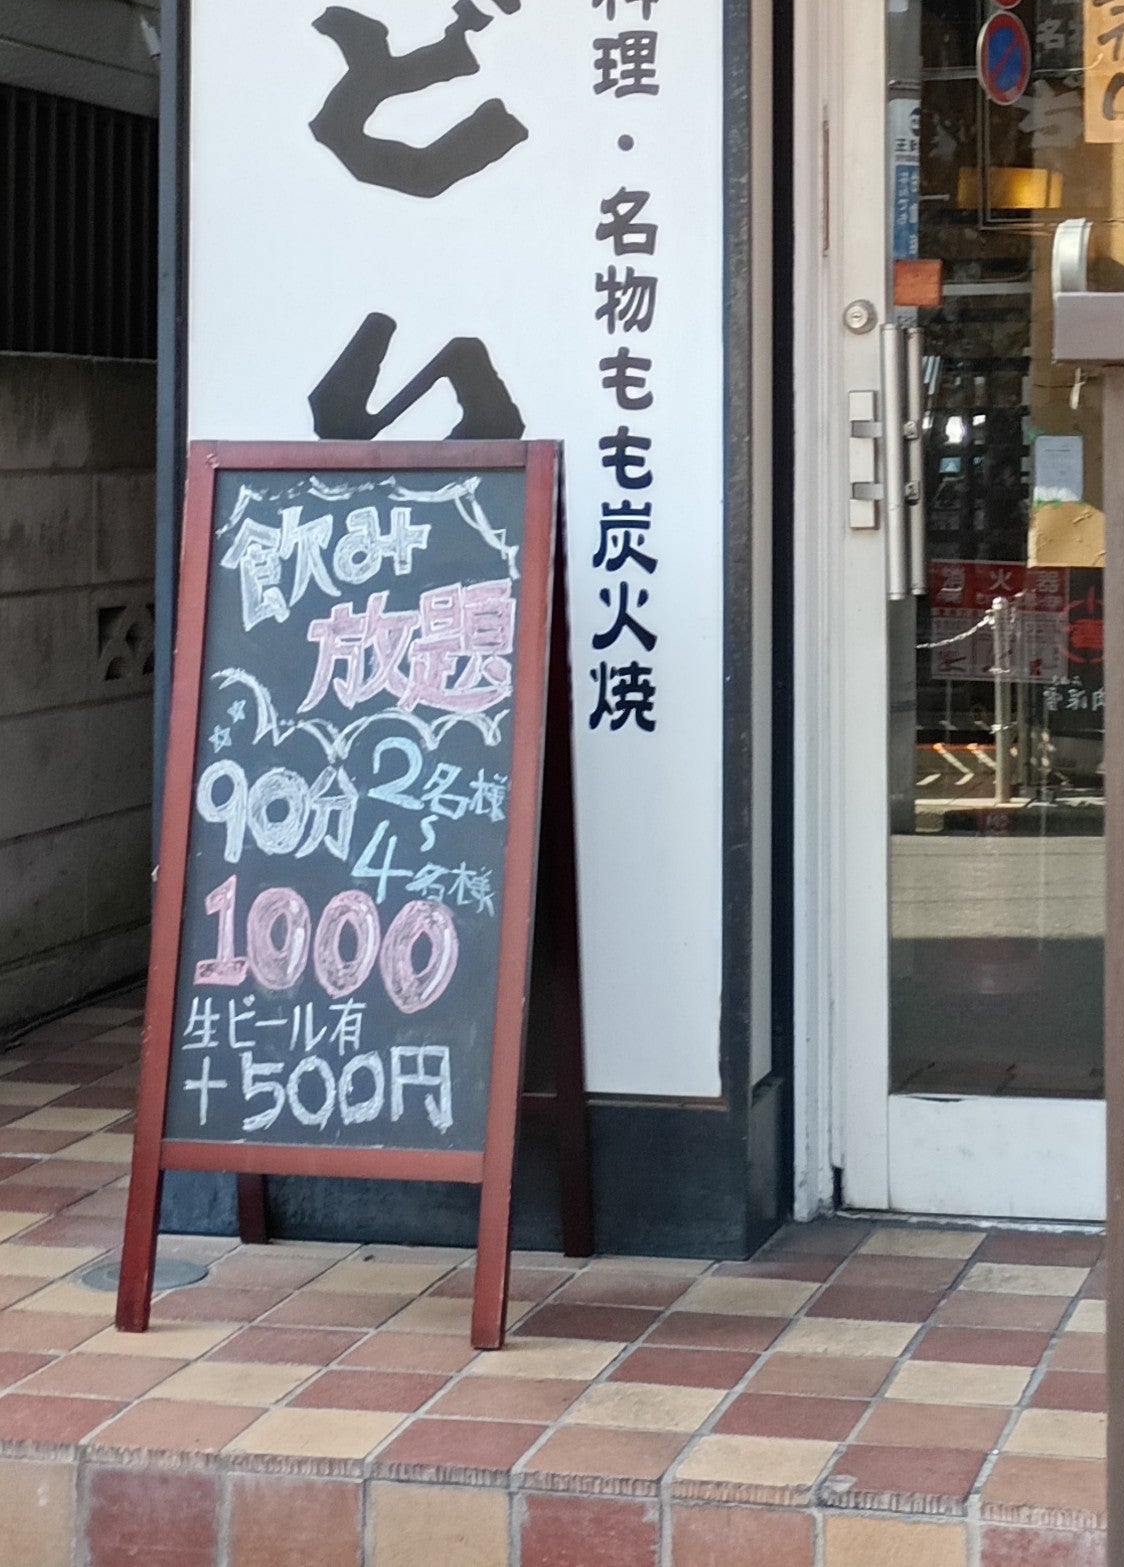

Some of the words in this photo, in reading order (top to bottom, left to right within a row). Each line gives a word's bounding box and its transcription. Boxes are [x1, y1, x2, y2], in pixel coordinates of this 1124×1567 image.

[221, 505, 430, 630] 飲み
[297, 578, 515, 713] 放題
[197, 759, 359, 862] 90分
[193, 875, 459, 1013] 1000
[183, 996, 367, 1054] 生ビール有
